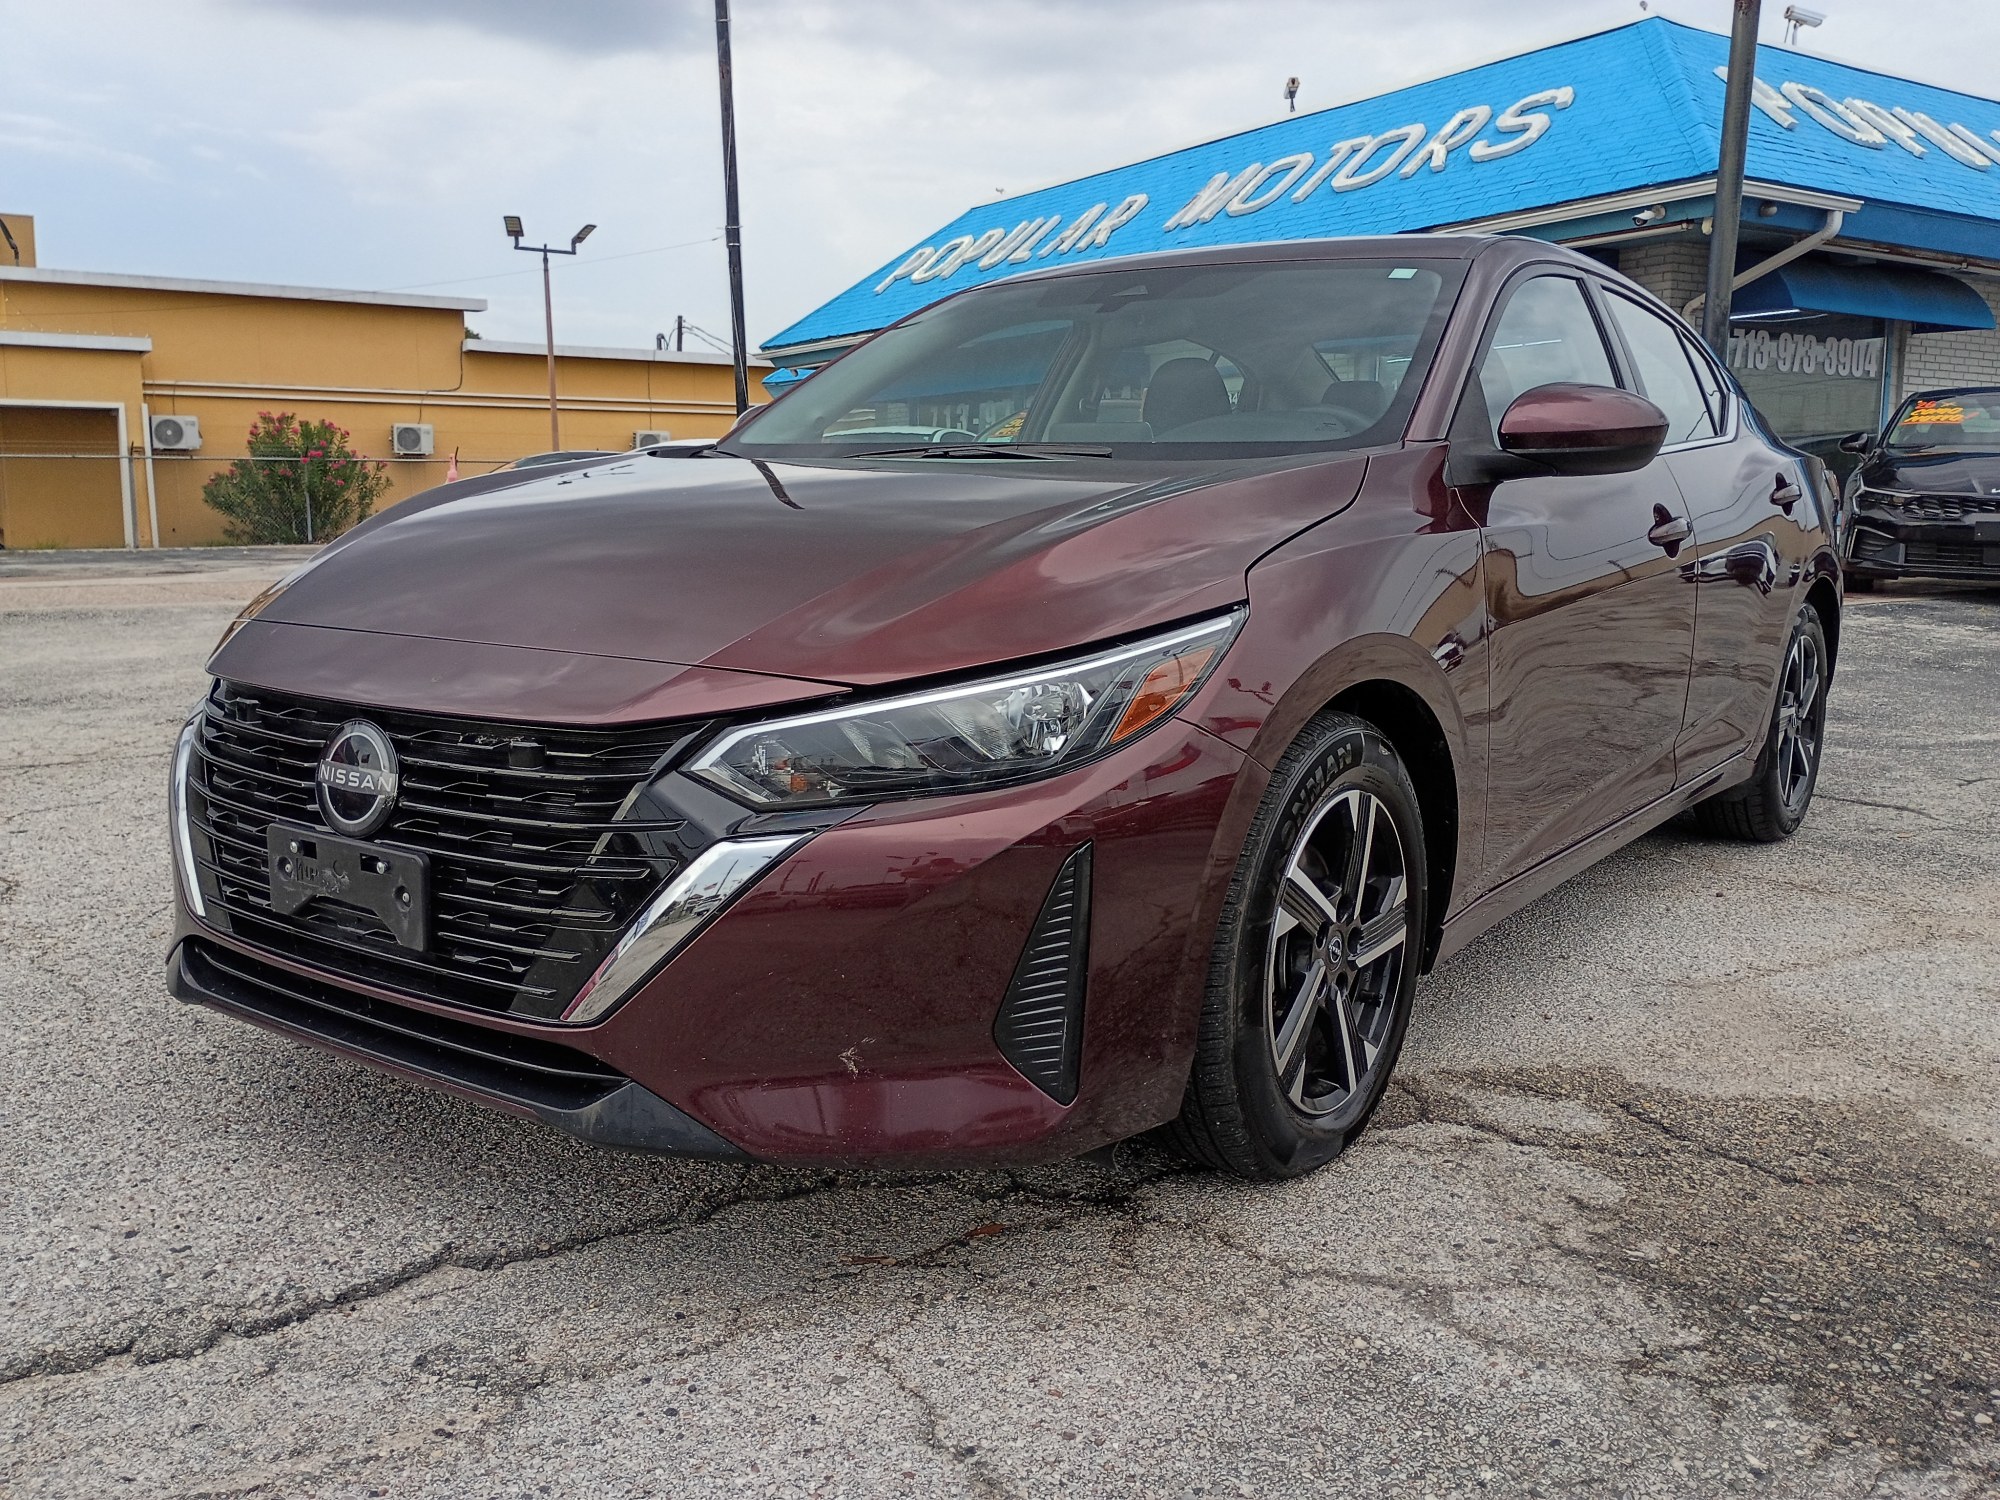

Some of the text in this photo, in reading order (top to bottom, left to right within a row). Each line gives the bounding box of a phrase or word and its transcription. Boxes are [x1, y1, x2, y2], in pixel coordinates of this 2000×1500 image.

[874, 85, 1575, 295] POPULAR MOTORS
[1733, 328, 1878, 378] 713-973-3904
[319, 763, 394, 792] NISSAN
